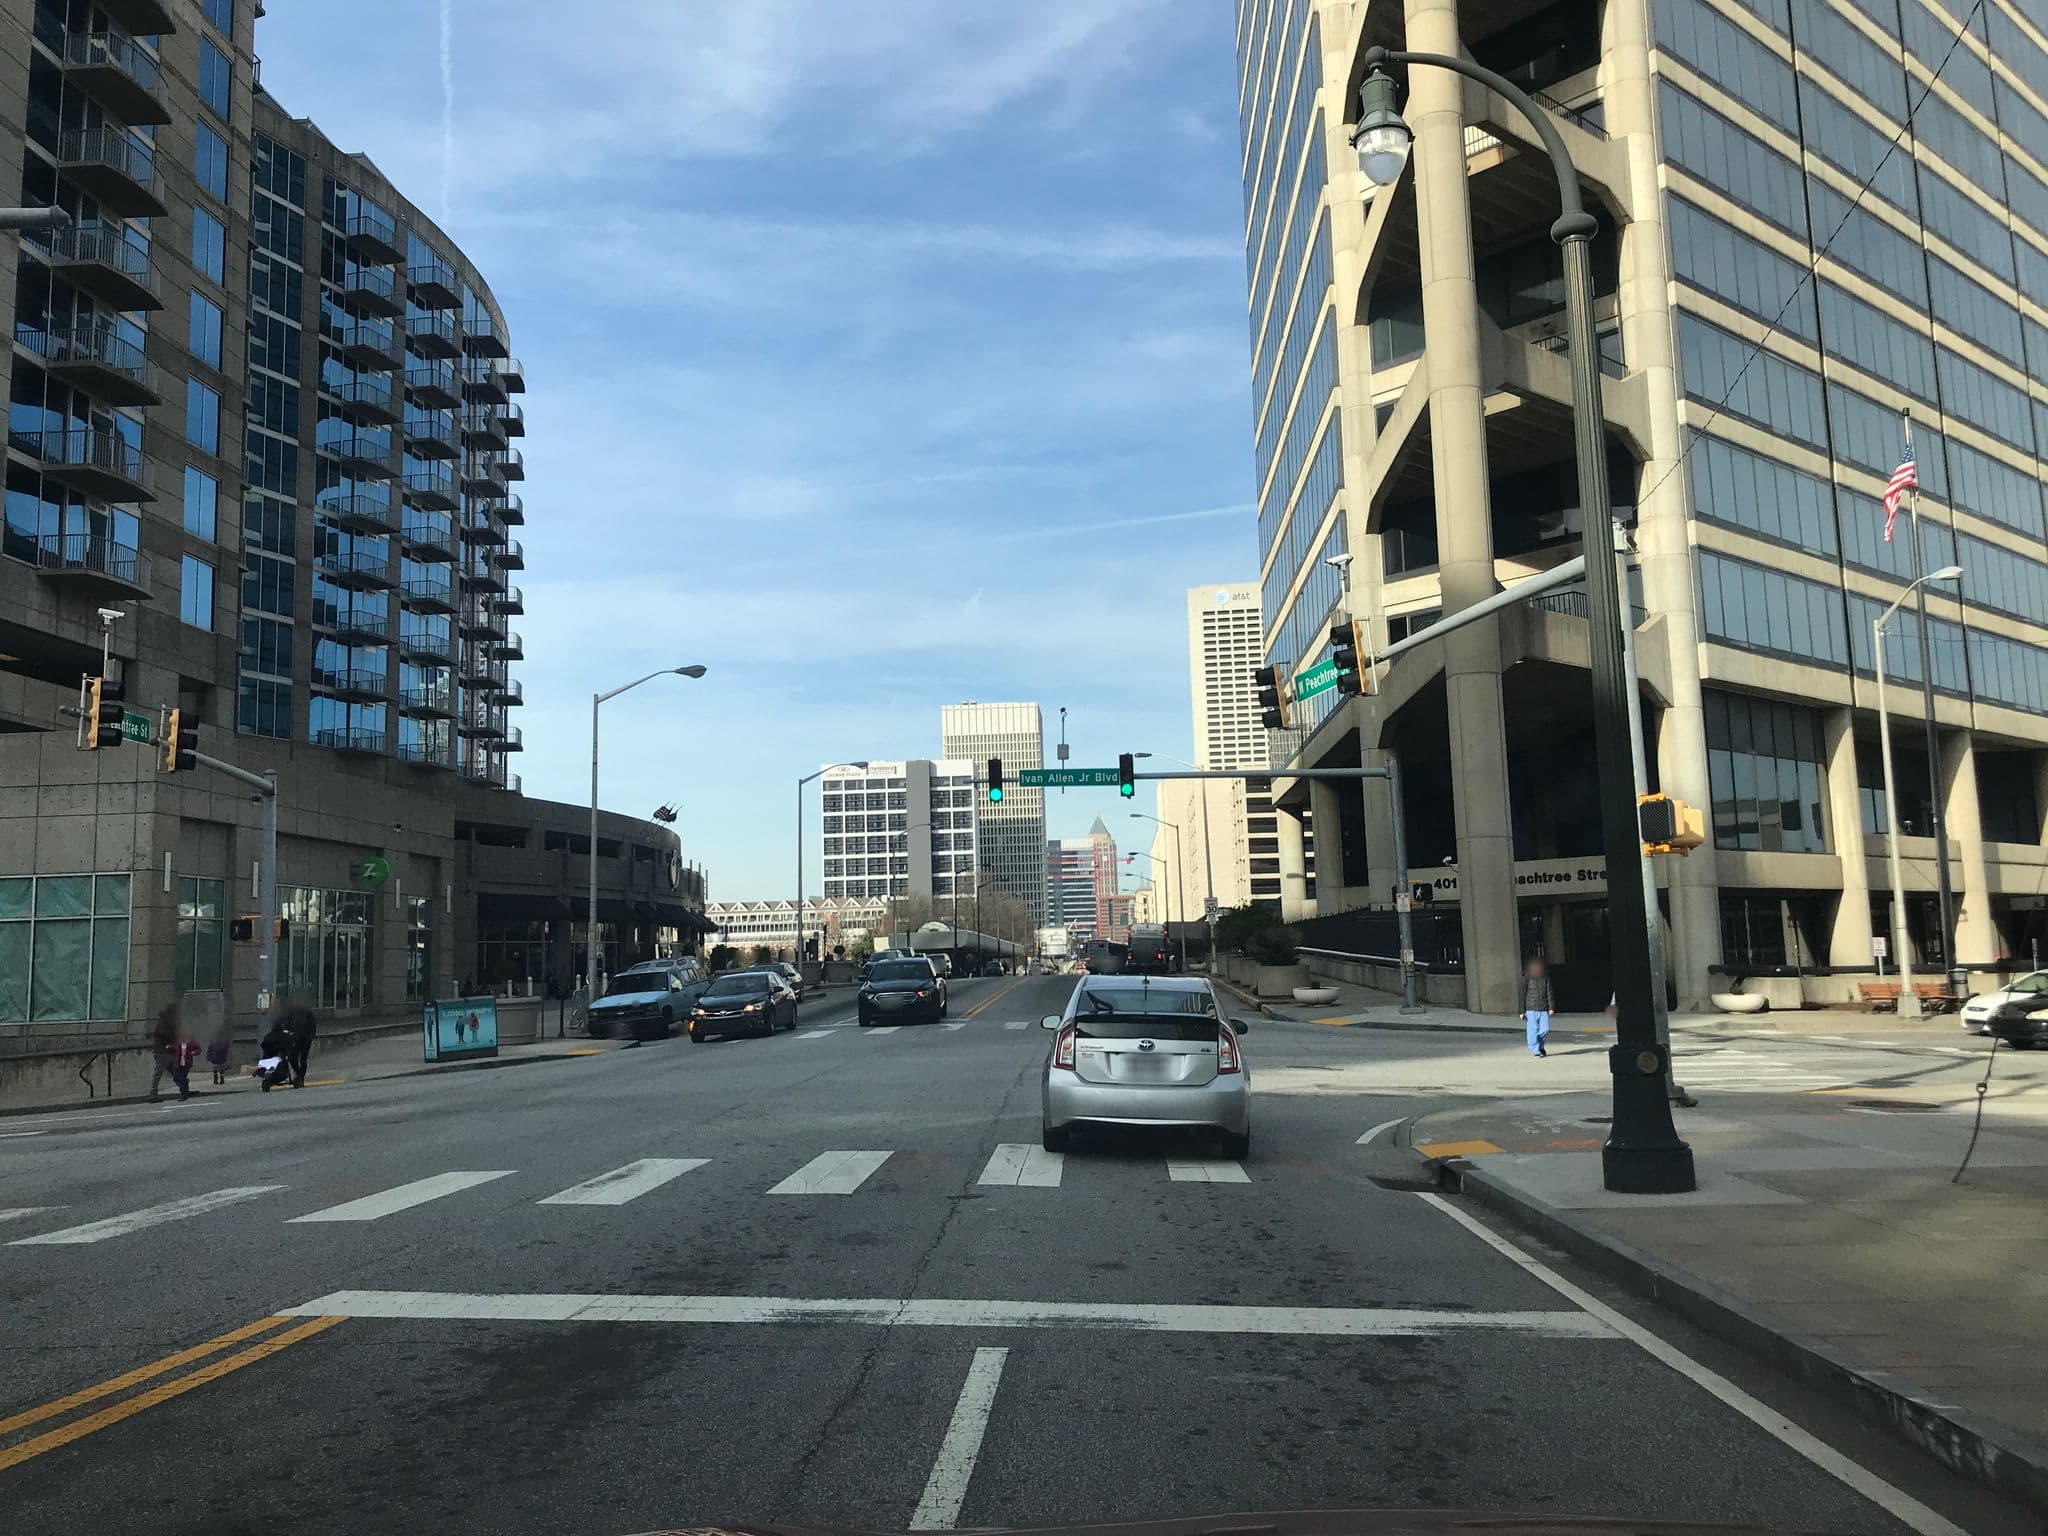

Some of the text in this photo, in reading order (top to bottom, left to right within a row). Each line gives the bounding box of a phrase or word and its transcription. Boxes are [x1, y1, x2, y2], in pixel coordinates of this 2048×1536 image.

[1232, 592, 1250, 601] at&t
[1305, 667, 1338, 692] Peachtree
[140, 723, 148, 738] St
[1021, 772, 1118, 783] Ivan Allen Jr Blvd
[1434, 869, 1608, 889] 401 achtree Stre
